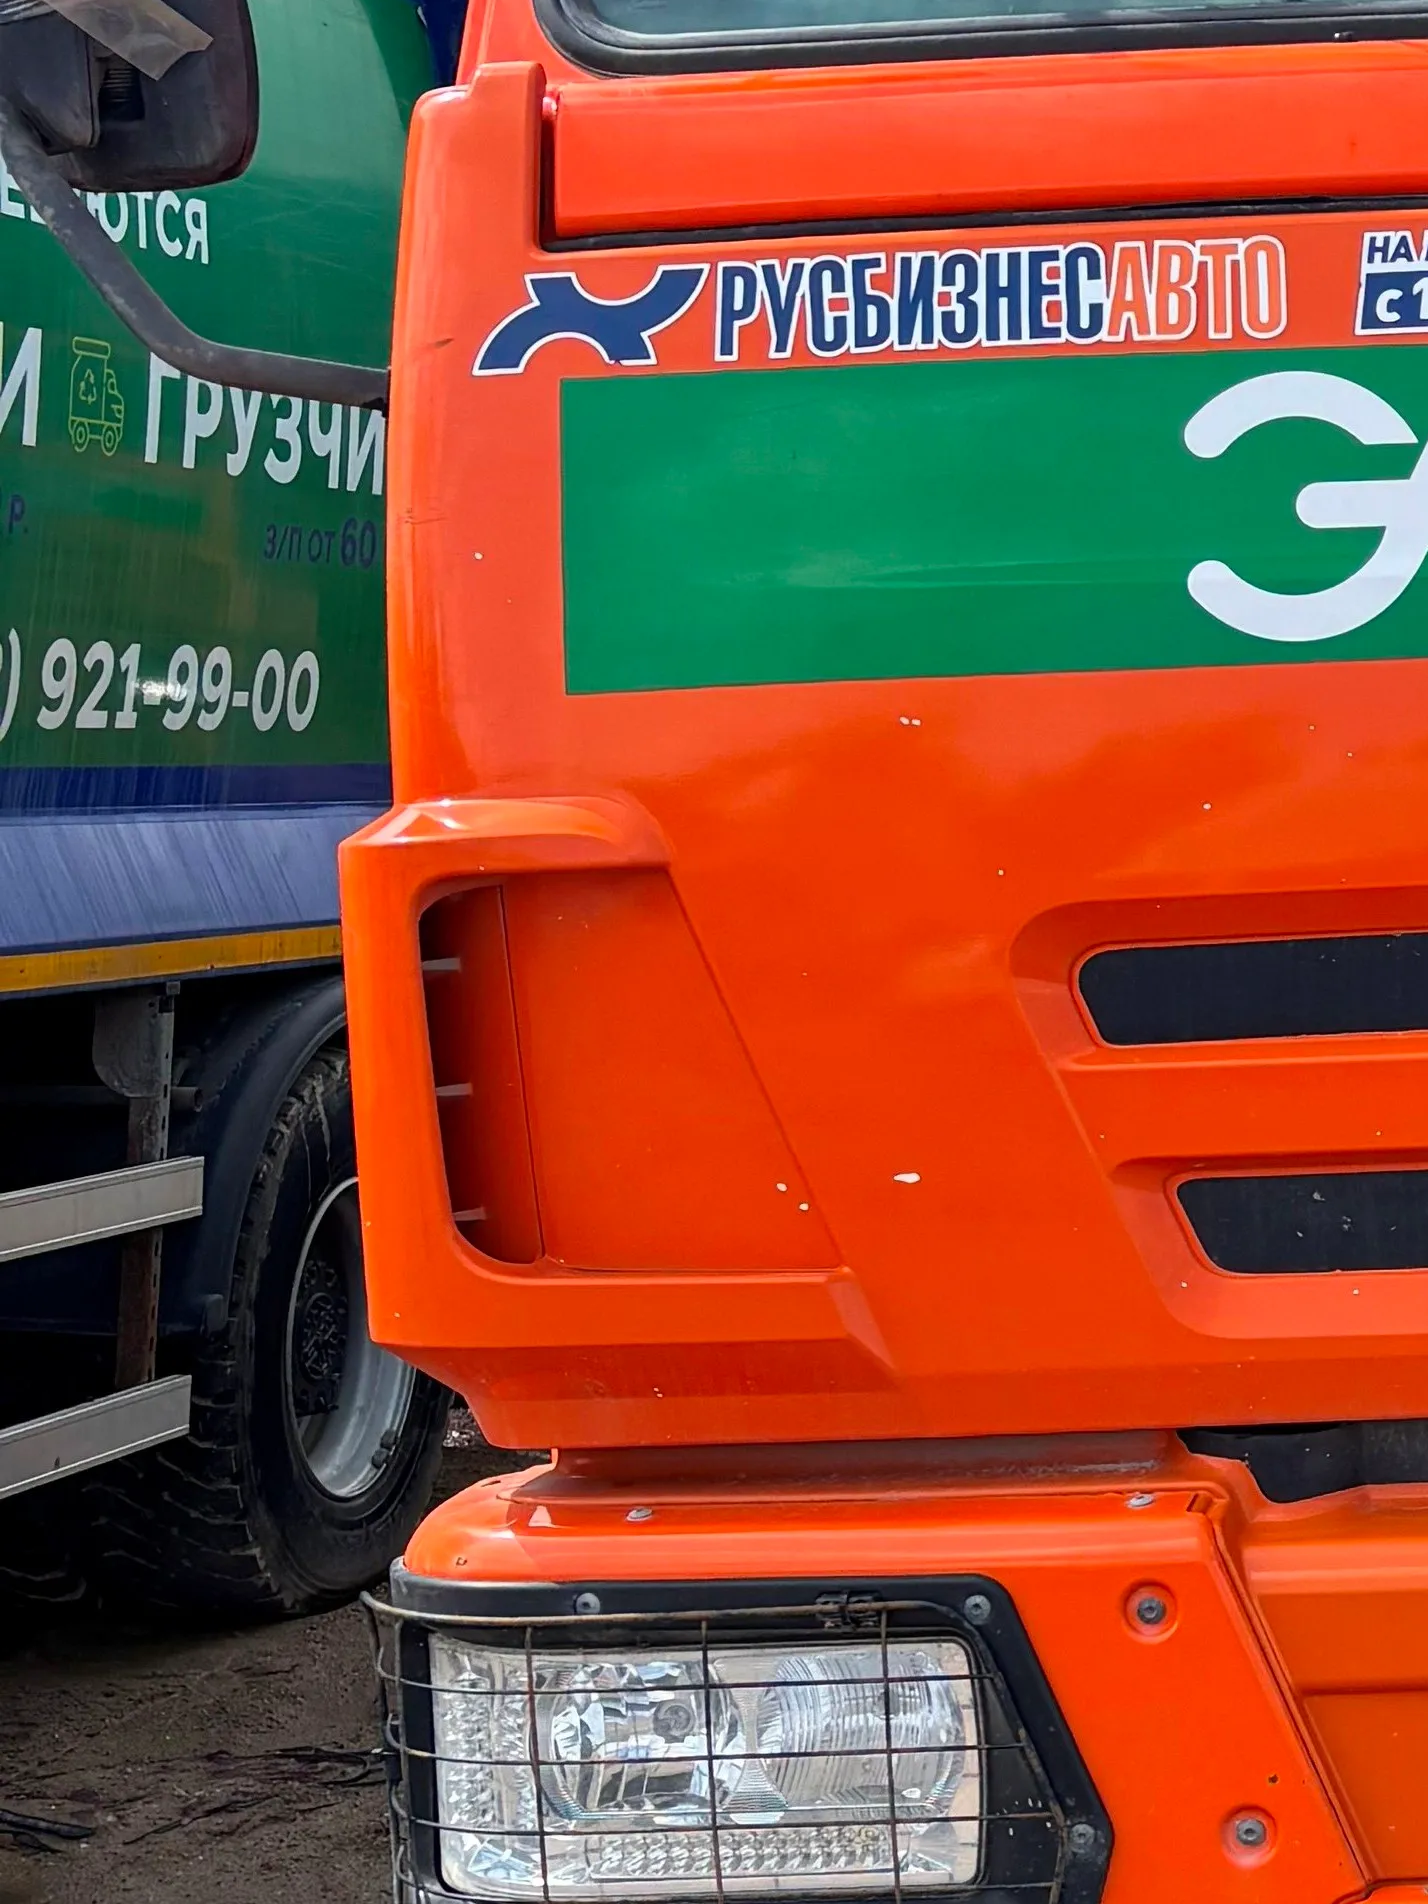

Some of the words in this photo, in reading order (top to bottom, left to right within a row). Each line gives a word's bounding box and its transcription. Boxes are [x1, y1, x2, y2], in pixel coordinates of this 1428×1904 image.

[1367, 234, 1418, 264] НА
[714, 235, 1288, 362] РУСБИЗНЕСАВТО
[37, 637, 320, 732] 921-99-00
